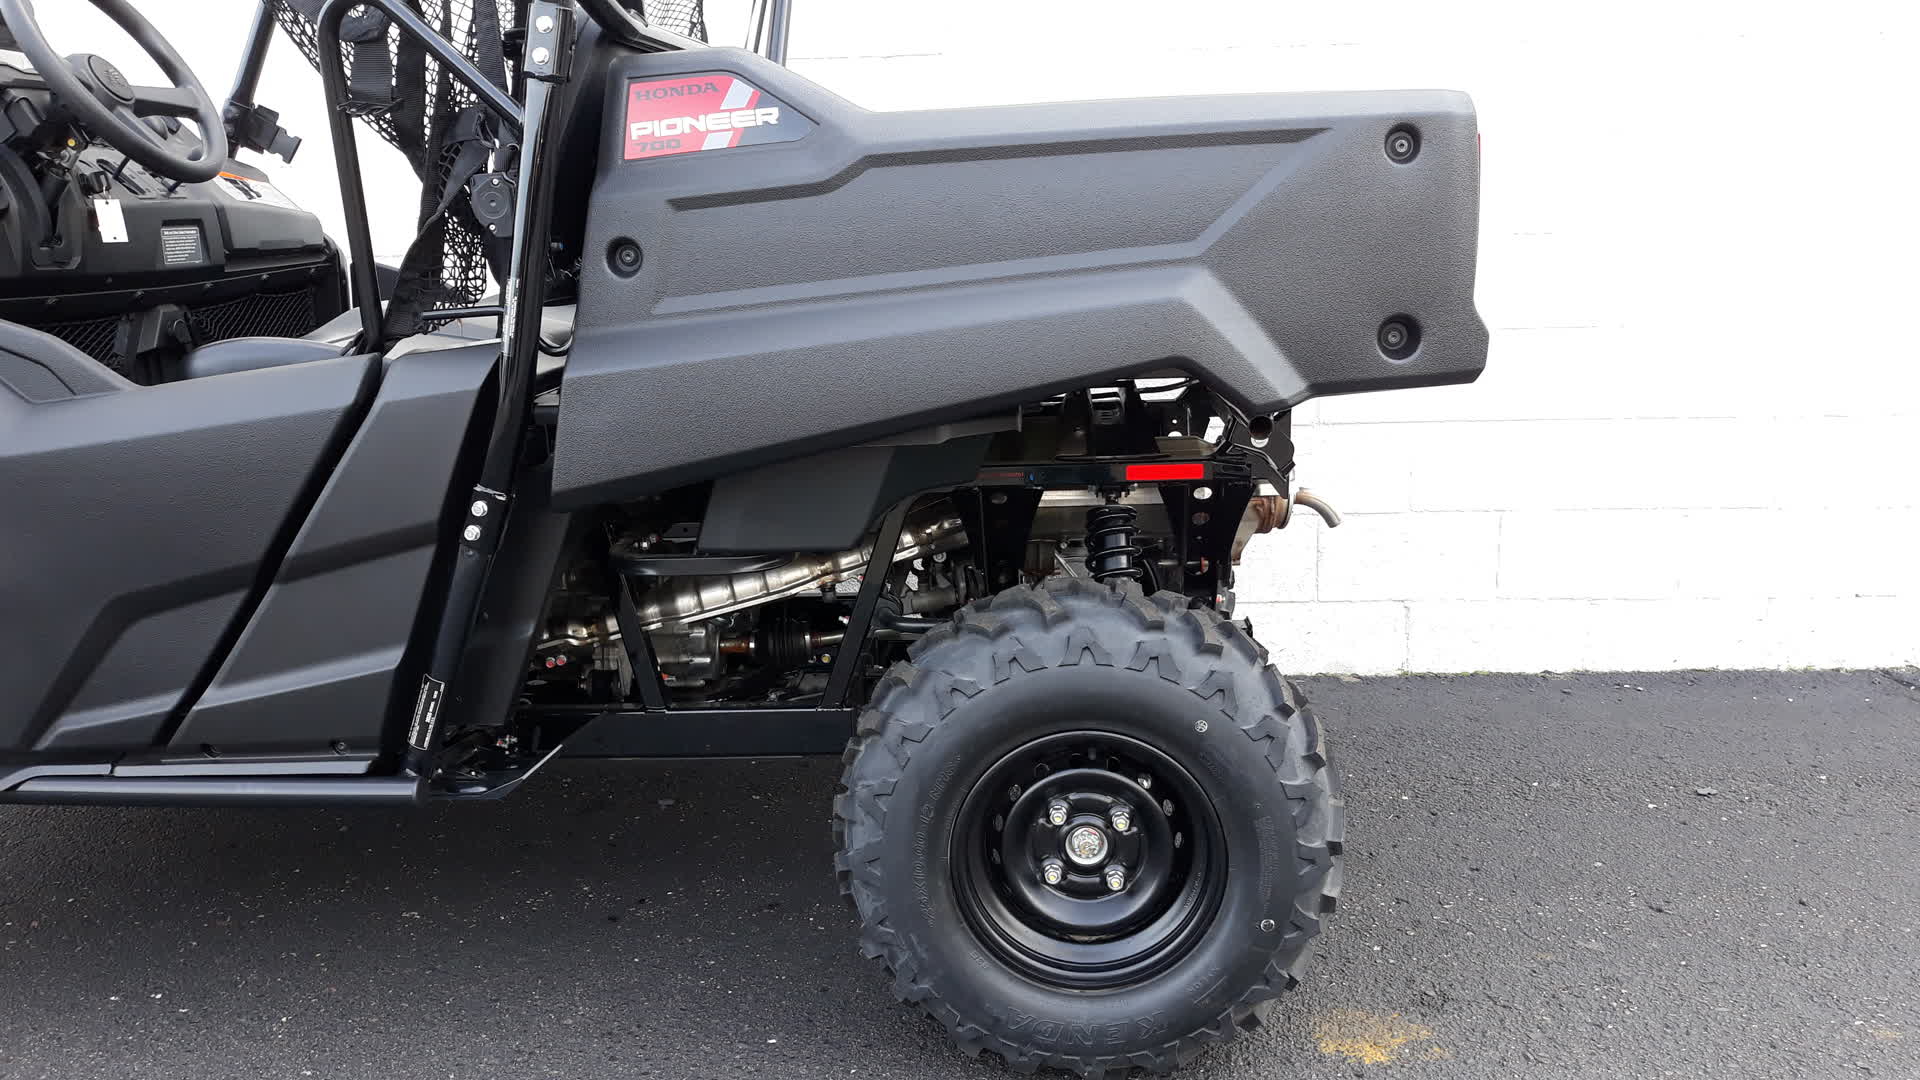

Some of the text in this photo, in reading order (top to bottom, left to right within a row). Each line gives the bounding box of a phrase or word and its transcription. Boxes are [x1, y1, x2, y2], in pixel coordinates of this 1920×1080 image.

[634, 82, 720, 101] HONDA
[630, 107, 779, 140] PIONEER
[633, 138, 681, 152] 700
[1008, 1006, 1168, 1046] KENDA
